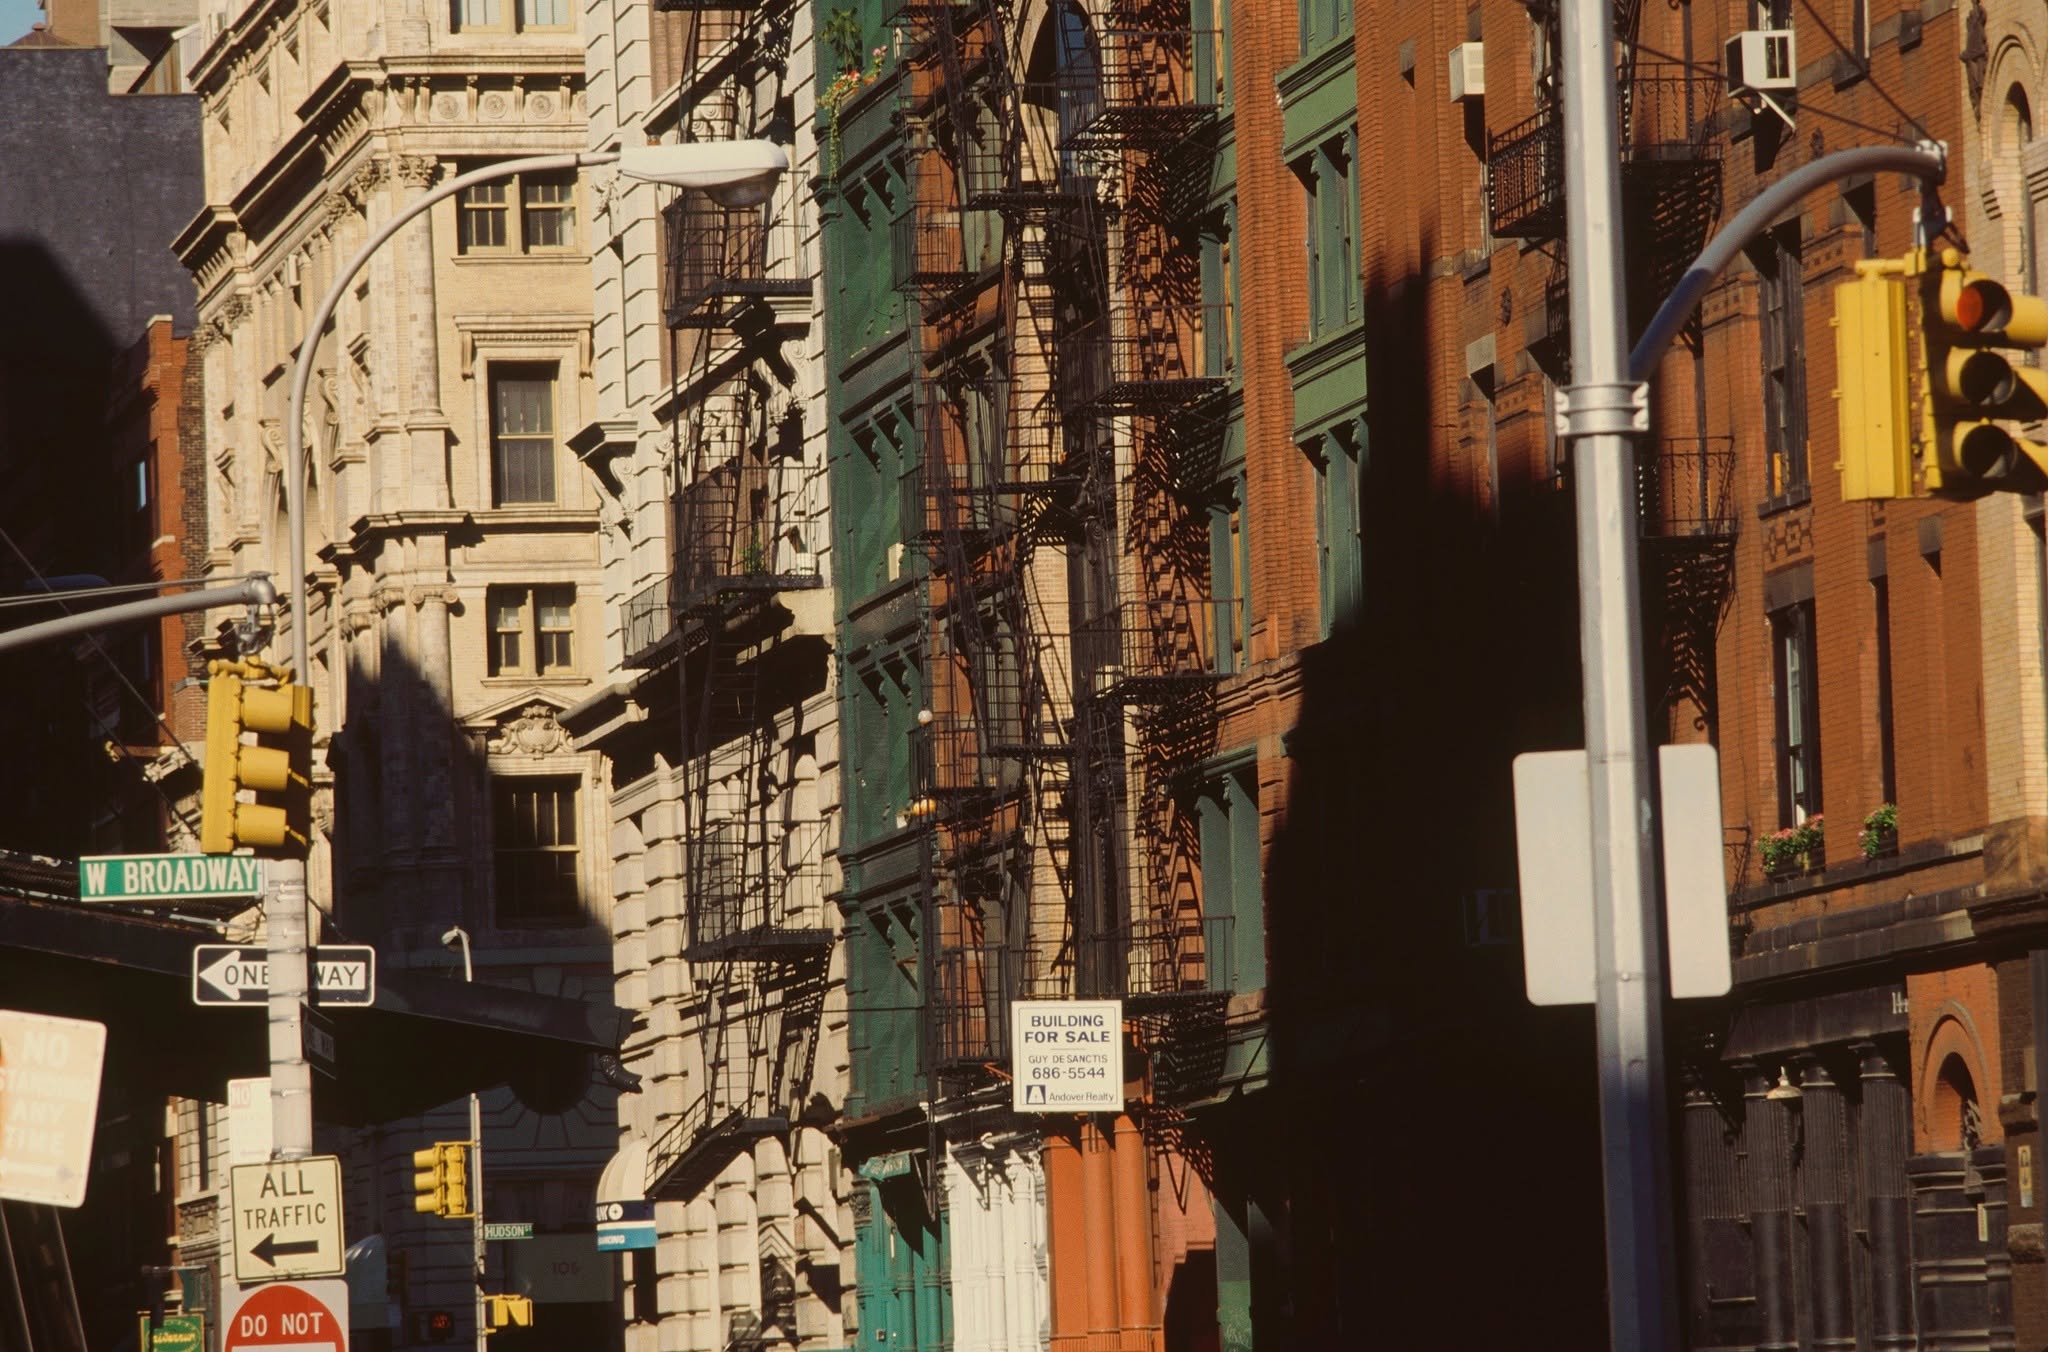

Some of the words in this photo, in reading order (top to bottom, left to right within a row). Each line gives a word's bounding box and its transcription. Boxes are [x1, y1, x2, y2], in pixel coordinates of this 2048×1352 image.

[86, 862, 107, 895] W
[124, 857, 257, 893] BROADWAY
[1031, 1015, 1104, 1027] BUILDING
[1024, 1031, 1058, 1043] FOR
[1065, 1031, 1110, 1043] SALE
[23, 1031, 69, 1068] NO
[1028, 1055, 1048, 1064] GUY
[1032, 1067, 1105, 1079] 686-5544
[1049, 1092, 1084, 1102] Andover
[1086, 1092, 1114, 1103] Realty
[260, 1170, 314, 1198] ALL
[244, 1202, 326, 1230] TRAFFIC
[486, 1225, 525, 1238] HUDSON
[241, 1315, 267, 1337] DO
[281, 1312, 324, 1336] NOT
